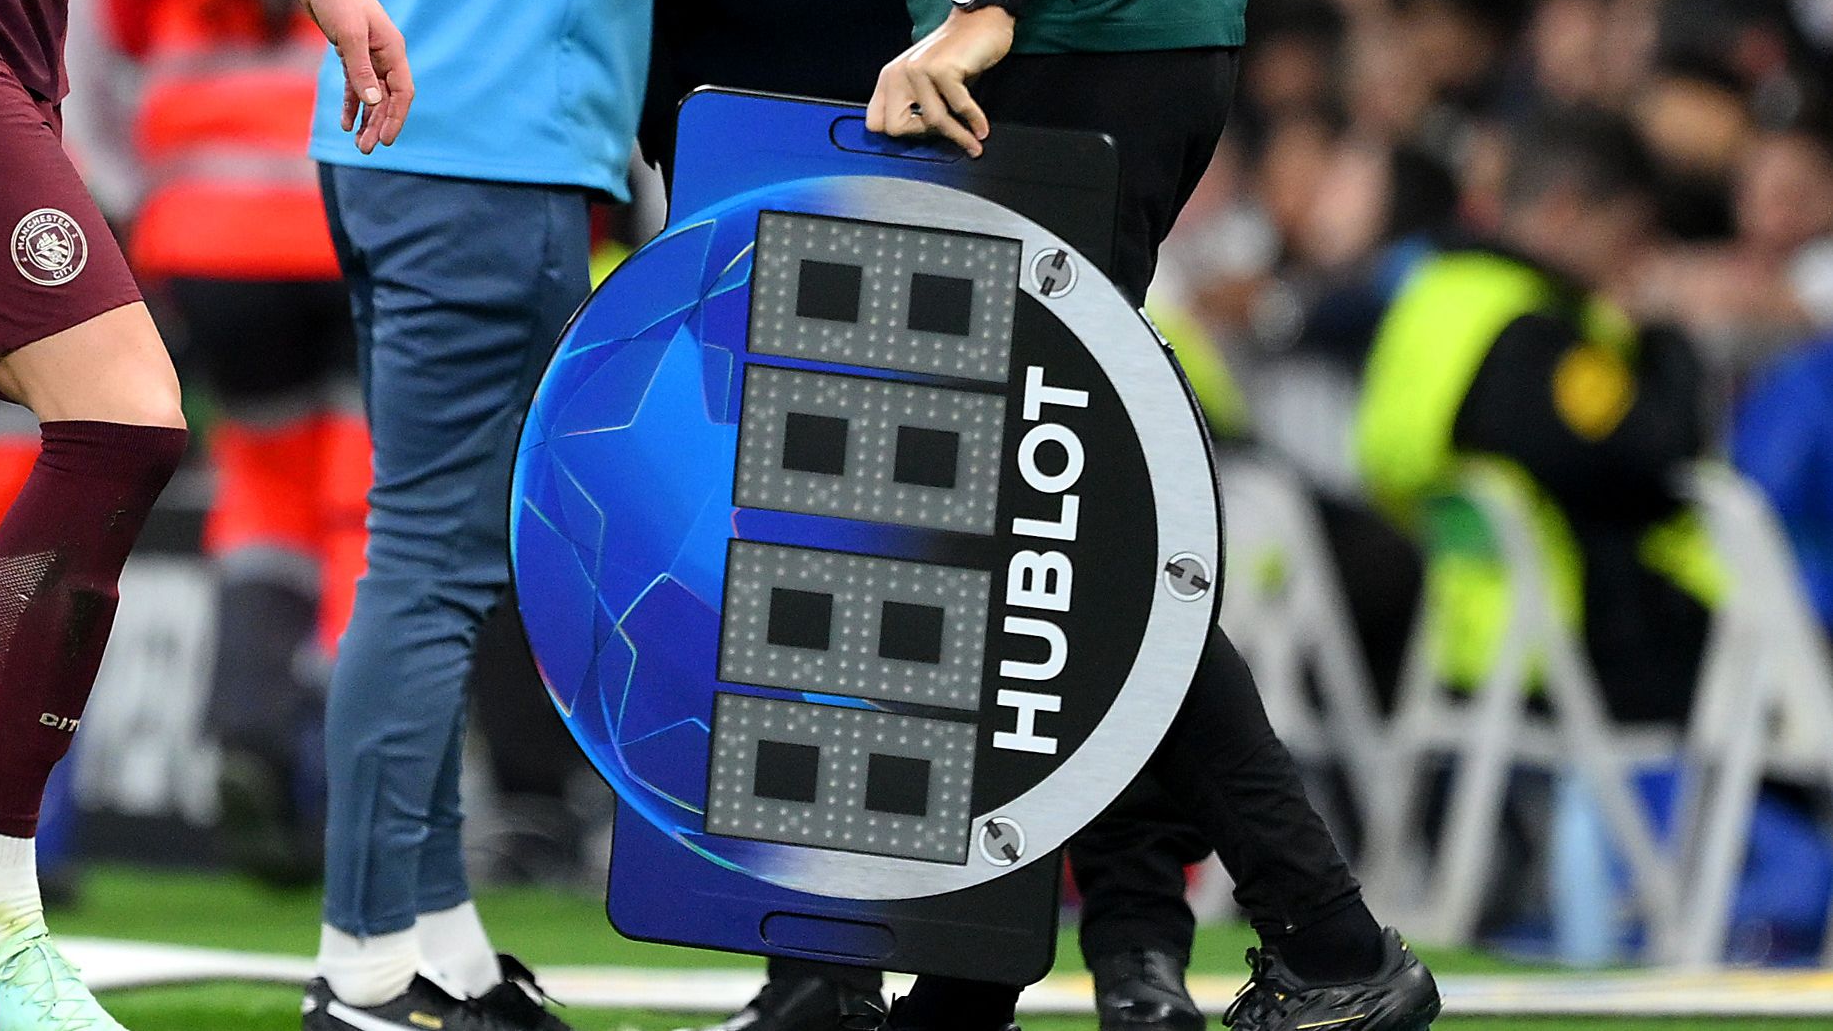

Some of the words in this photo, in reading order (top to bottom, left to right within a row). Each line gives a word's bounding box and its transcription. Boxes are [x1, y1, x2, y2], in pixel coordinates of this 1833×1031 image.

[17, 214, 71, 250] MANCHESTER
[53, 265, 74, 280] CITY
[992, 365, 1090, 755] HUBLOT
[39, 712, 81, 732] CIT
